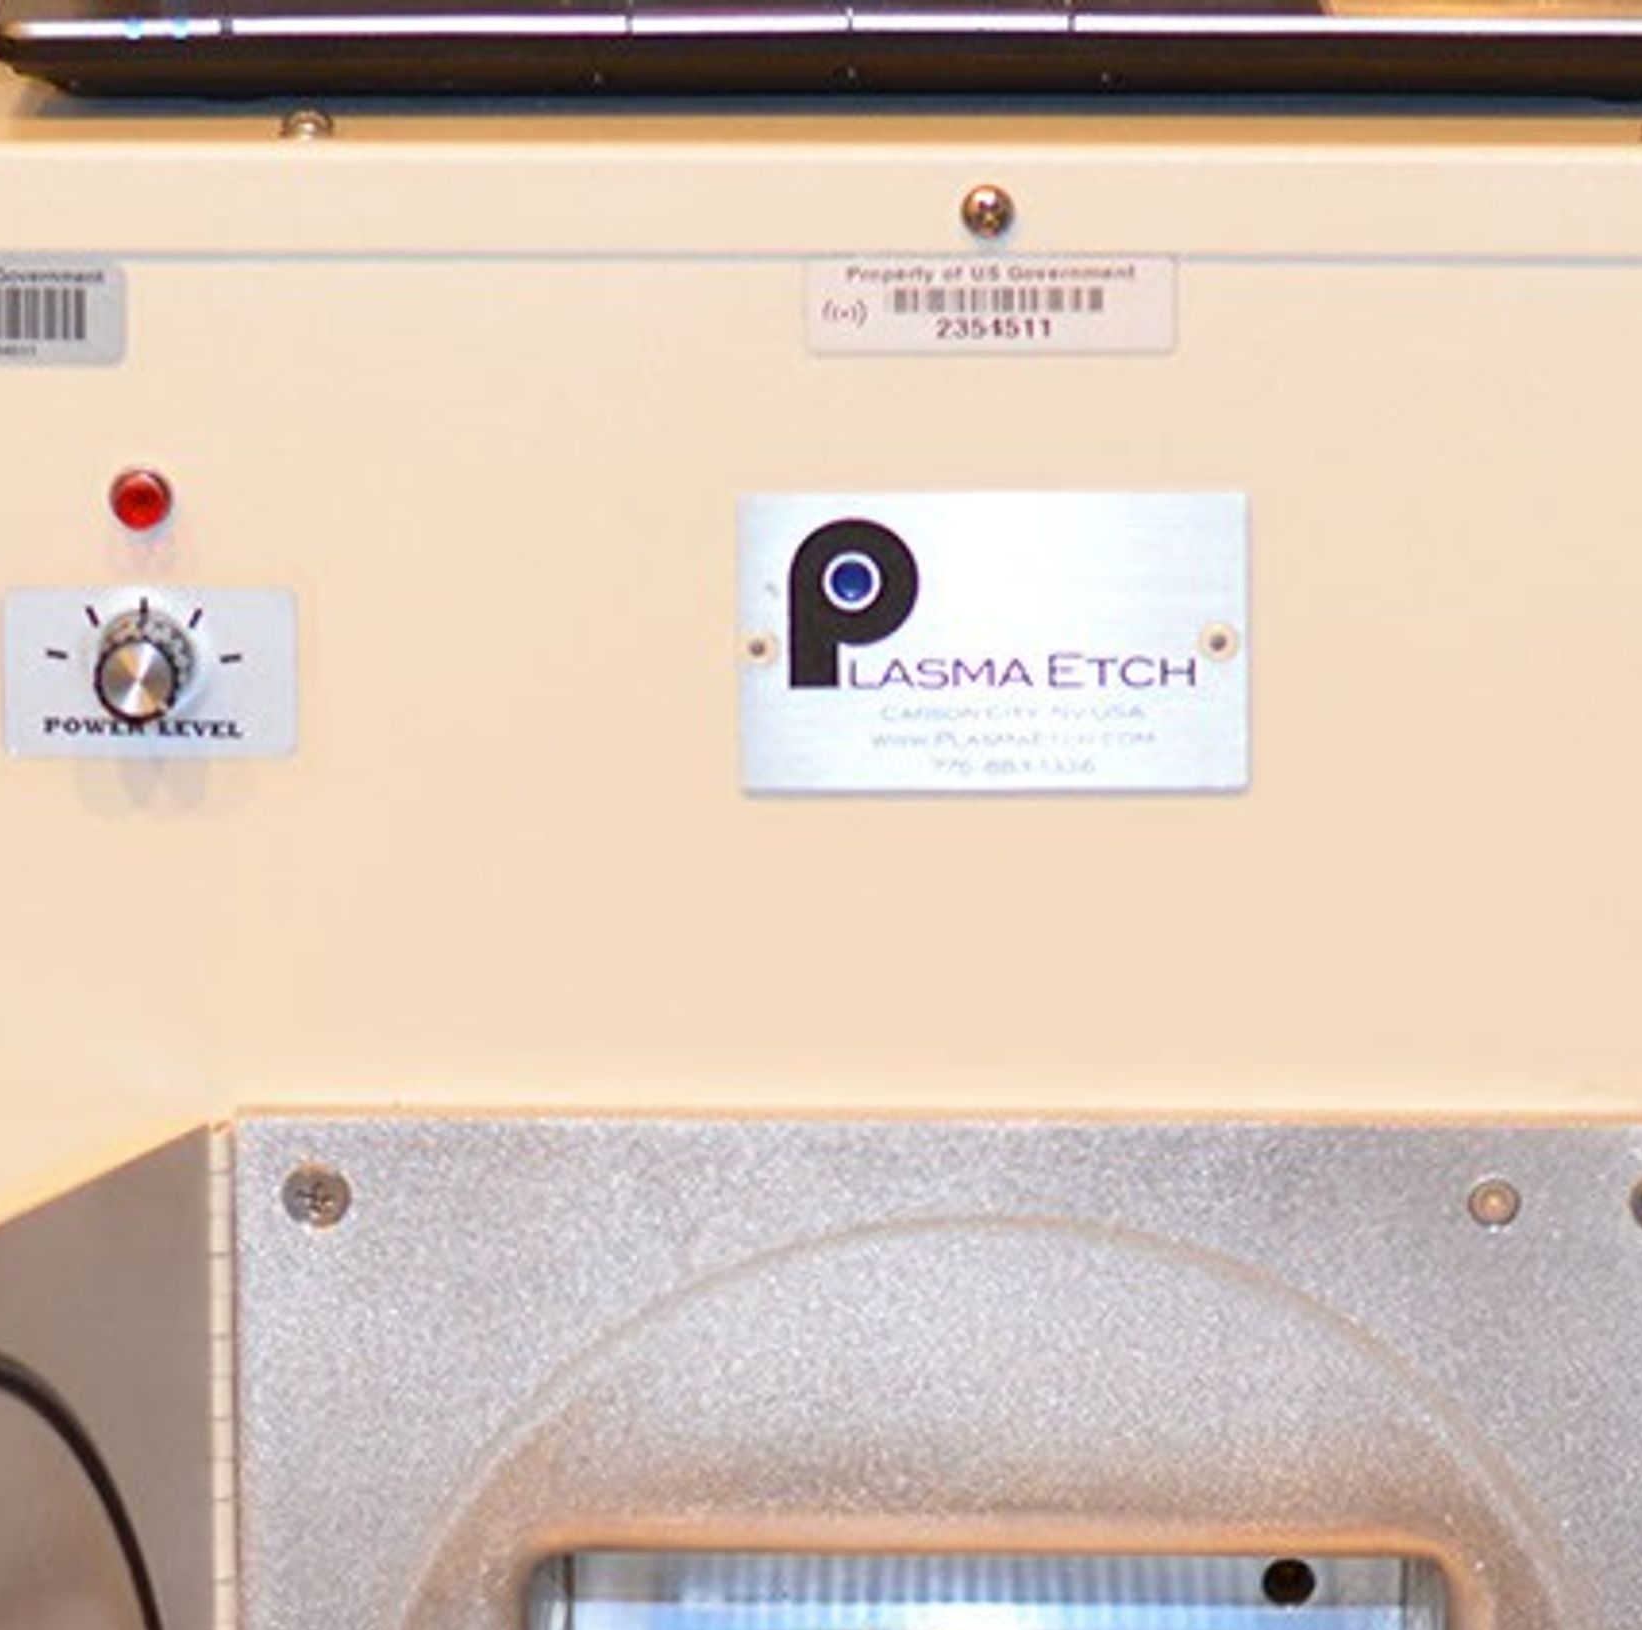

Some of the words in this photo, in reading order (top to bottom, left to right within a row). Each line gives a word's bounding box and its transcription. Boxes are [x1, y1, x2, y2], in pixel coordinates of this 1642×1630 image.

[846, 266, 934, 283] Property
[942, 266, 962, 281] of
[970, 266, 1001, 281] US
[1008, 265, 1135, 282] Government
[936, 317, 1052, 340] 2354511
[1047, 653, 1197, 688] ETCH
[156, 718, 244, 739] LEVEL
